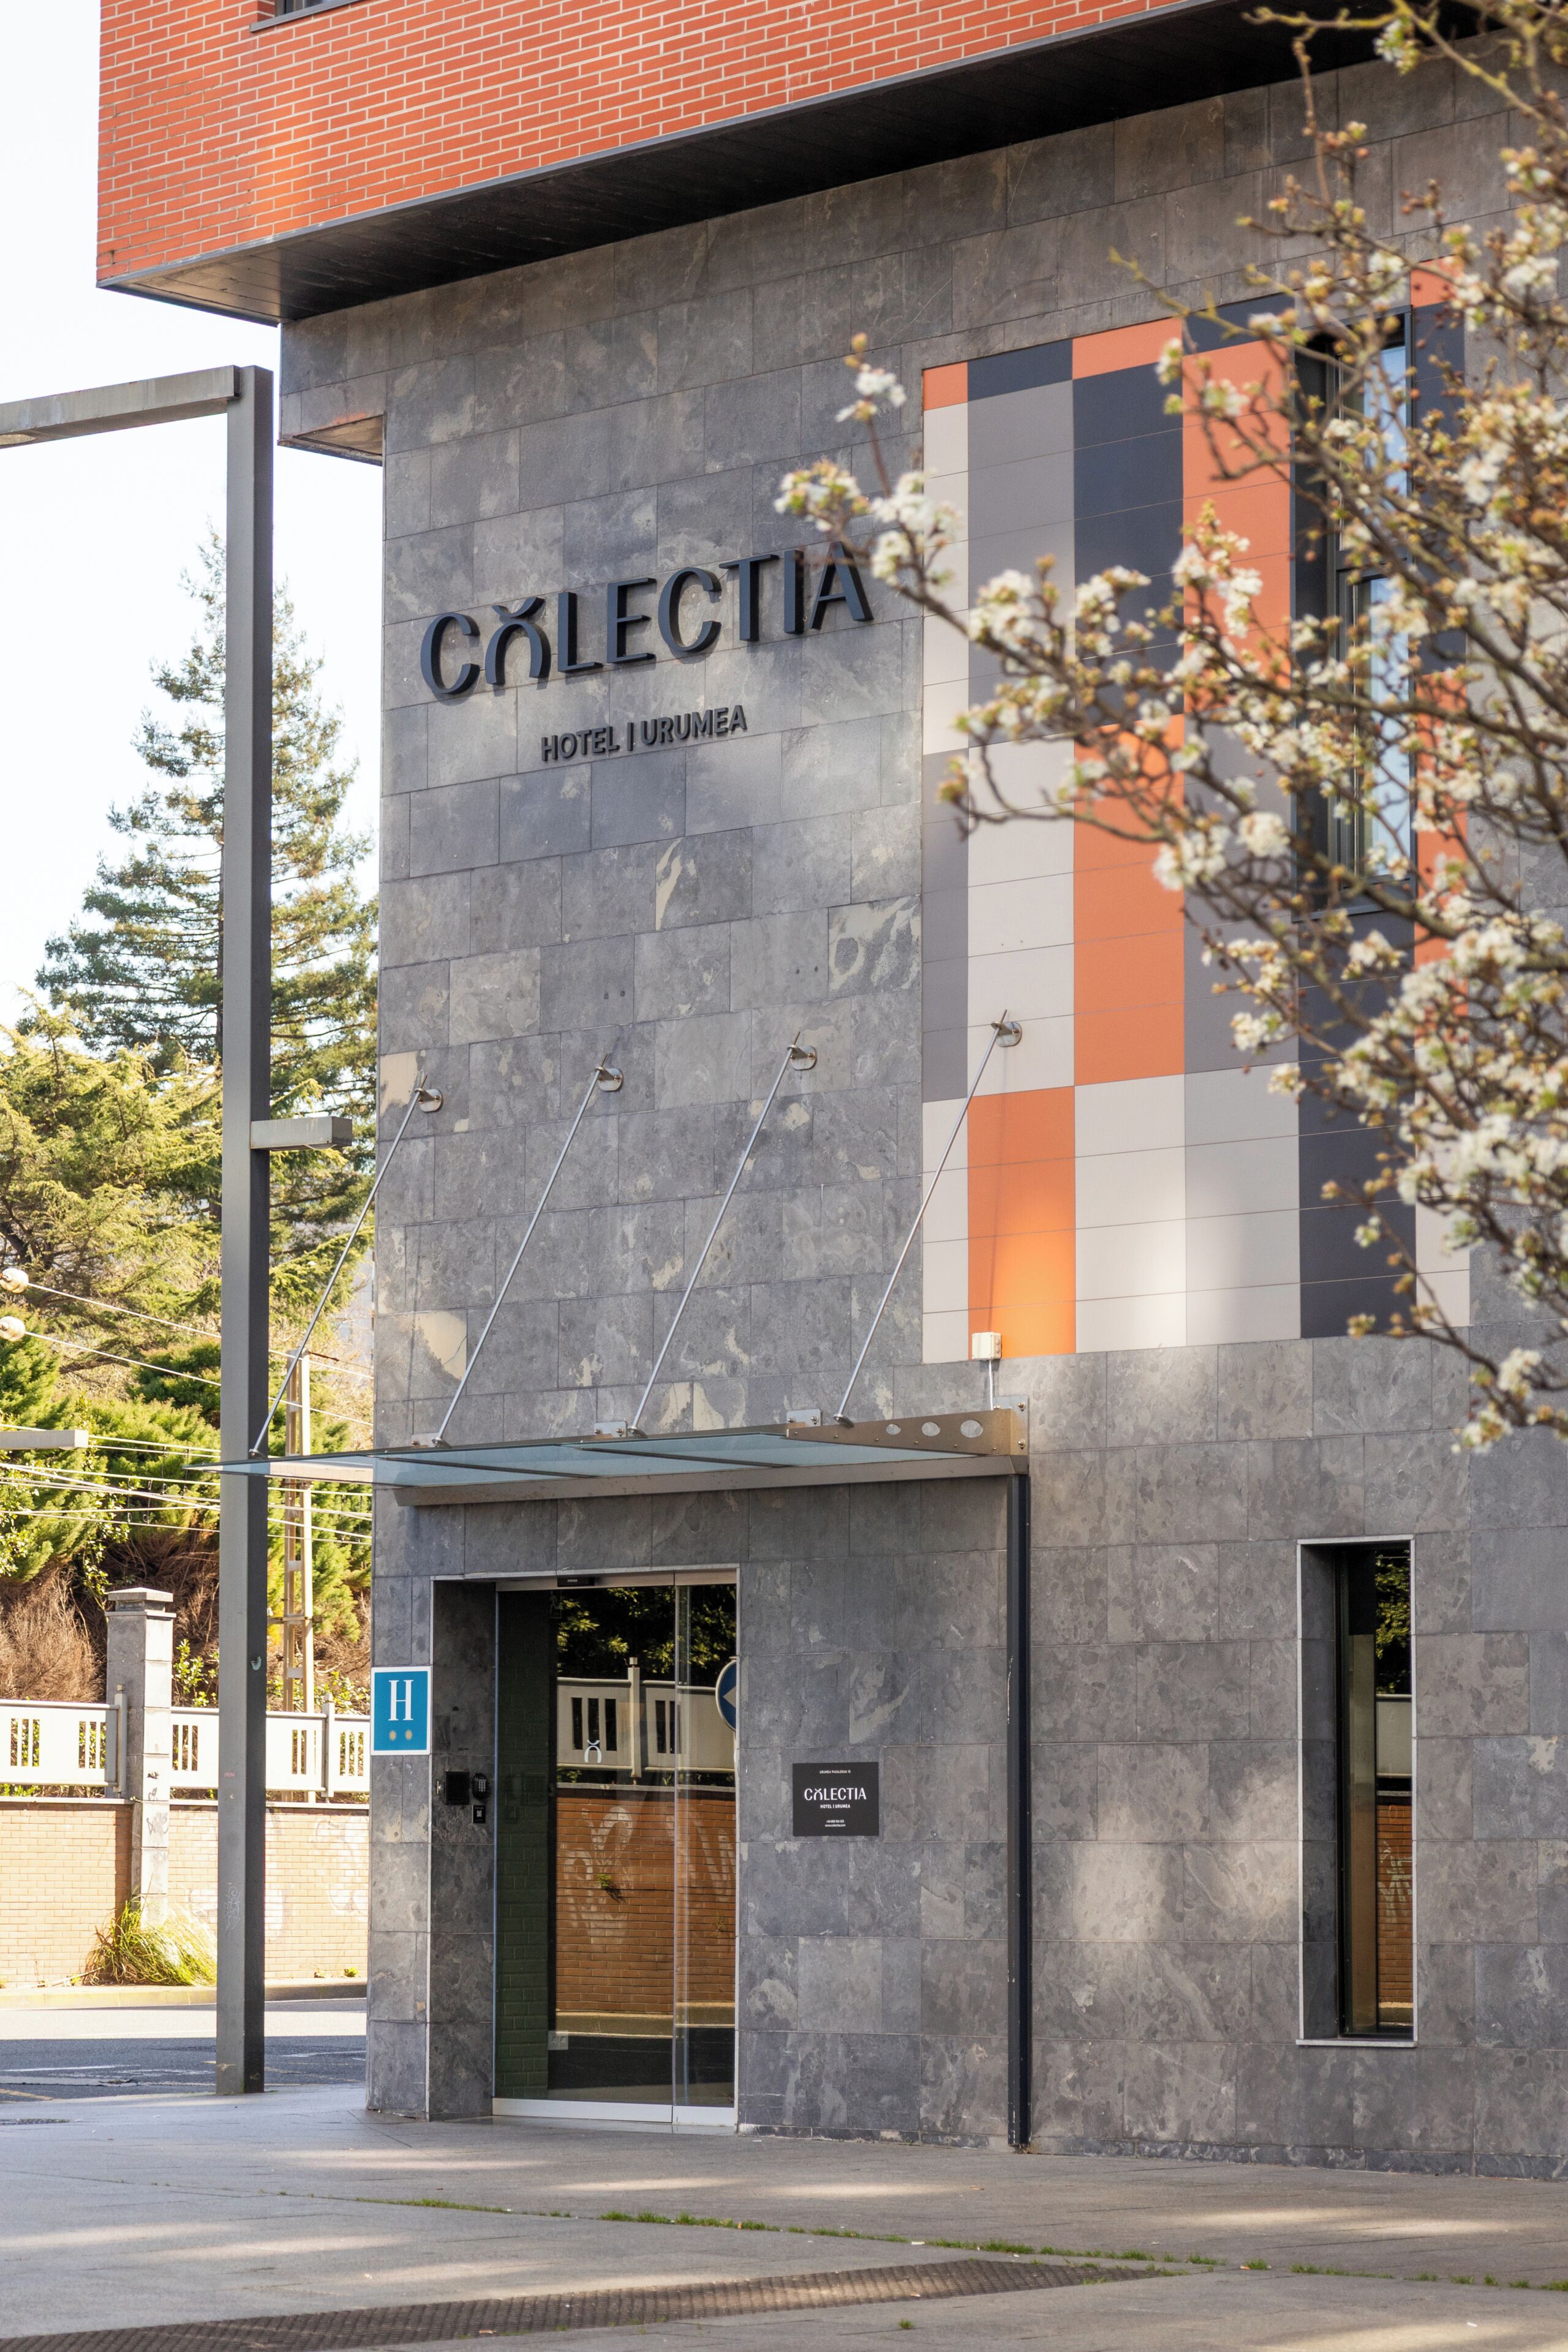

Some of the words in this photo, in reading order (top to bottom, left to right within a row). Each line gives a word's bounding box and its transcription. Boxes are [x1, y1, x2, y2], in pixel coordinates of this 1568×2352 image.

[541, 725, 619, 761] HOTEL
[640, 704, 747, 746] URUMEA
[388, 1679, 414, 1721] H
